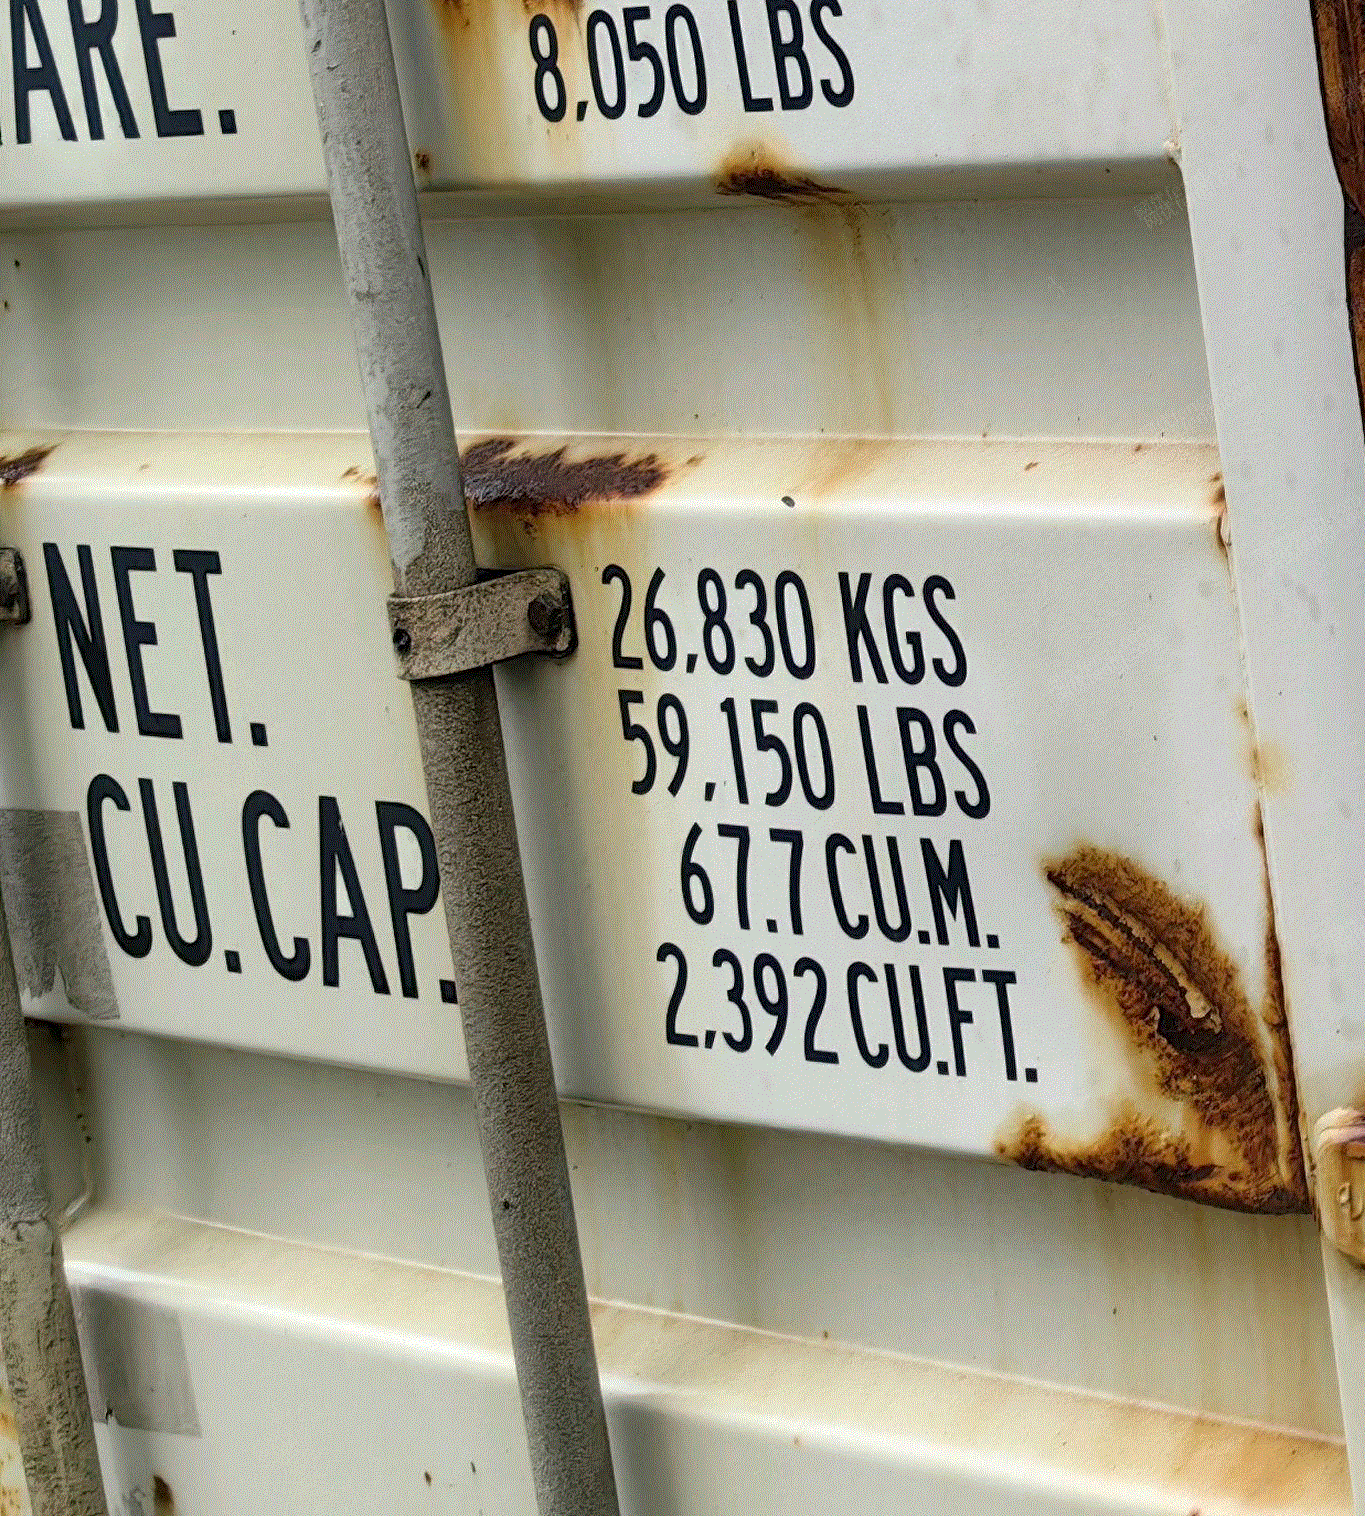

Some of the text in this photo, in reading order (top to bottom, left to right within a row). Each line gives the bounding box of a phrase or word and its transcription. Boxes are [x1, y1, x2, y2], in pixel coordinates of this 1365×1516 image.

[528, 3, 708, 123] 8,050
[42, 542, 270, 748] NET.
[601, 563, 968, 688] 26,830 KGS
[617, 688, 991, 820] 59,150 LBS
